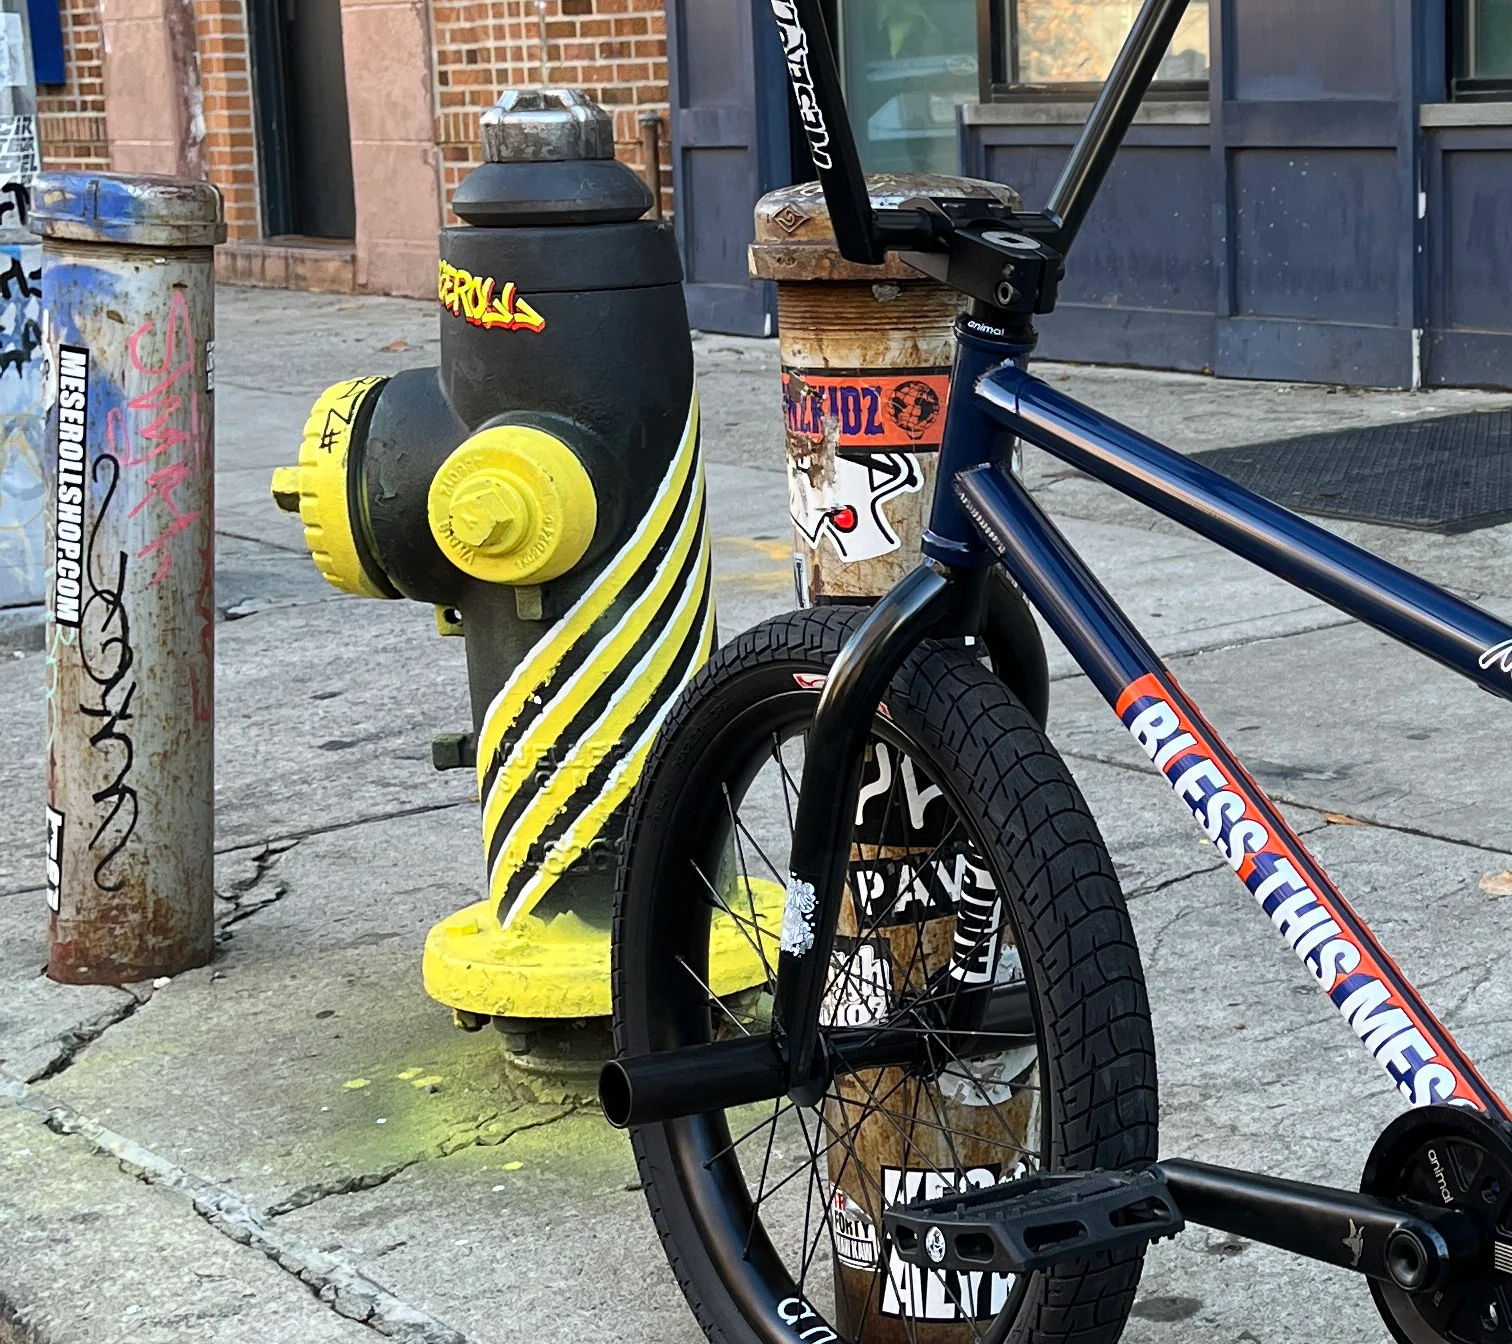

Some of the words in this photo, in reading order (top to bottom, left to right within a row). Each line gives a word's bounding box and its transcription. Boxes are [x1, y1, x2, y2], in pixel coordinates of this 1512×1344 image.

[967, 320, 1005, 336] animal
[55, 350, 88, 624] MESEROLLSHOP.COM
[1128, 700, 1269, 872] BLESS
[1253, 856, 1361, 992] THIS
[1338, 978, 1480, 1109] MES
[1428, 1149, 1454, 1204] animal
